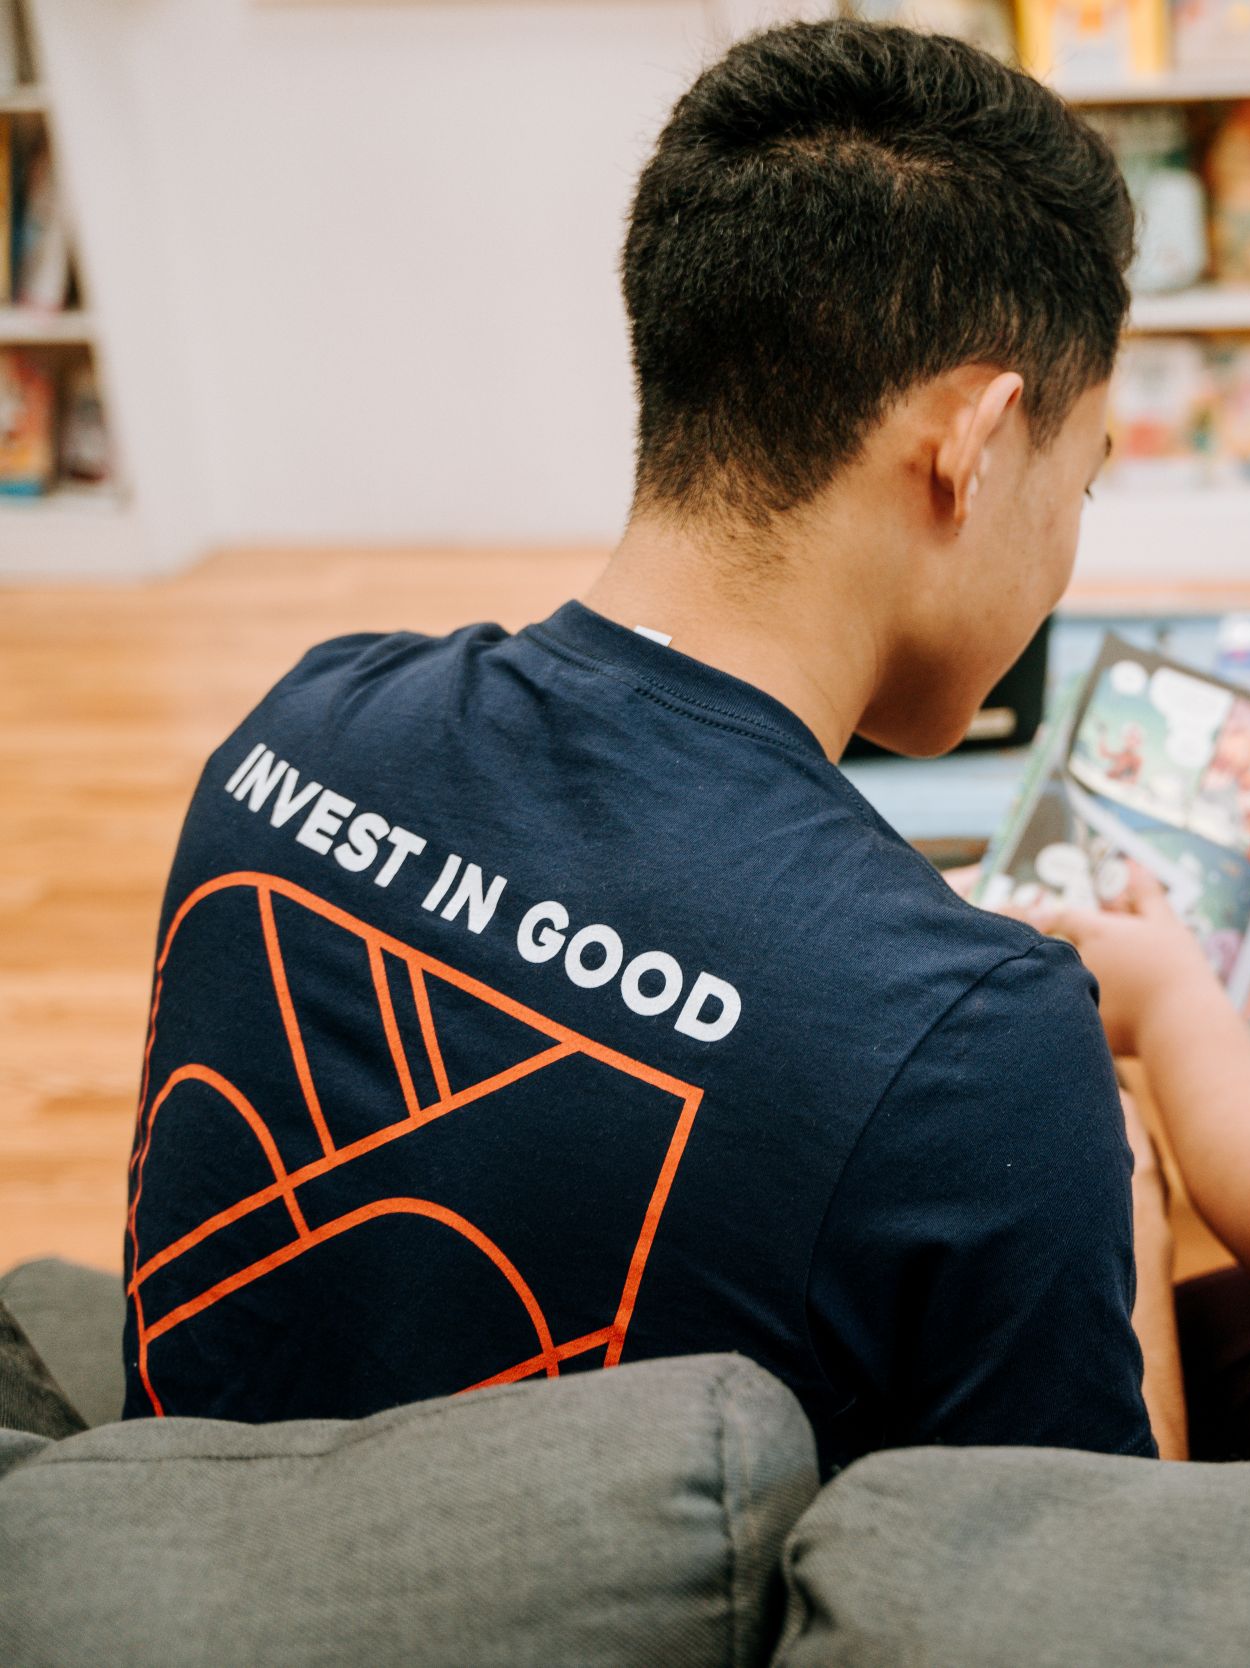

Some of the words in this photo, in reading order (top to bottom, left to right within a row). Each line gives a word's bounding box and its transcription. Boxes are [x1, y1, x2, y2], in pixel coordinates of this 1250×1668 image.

[225, 743, 427, 888] INVEST
[421, 854, 508, 934] IN
[516, 900, 742, 1042] GOOD
